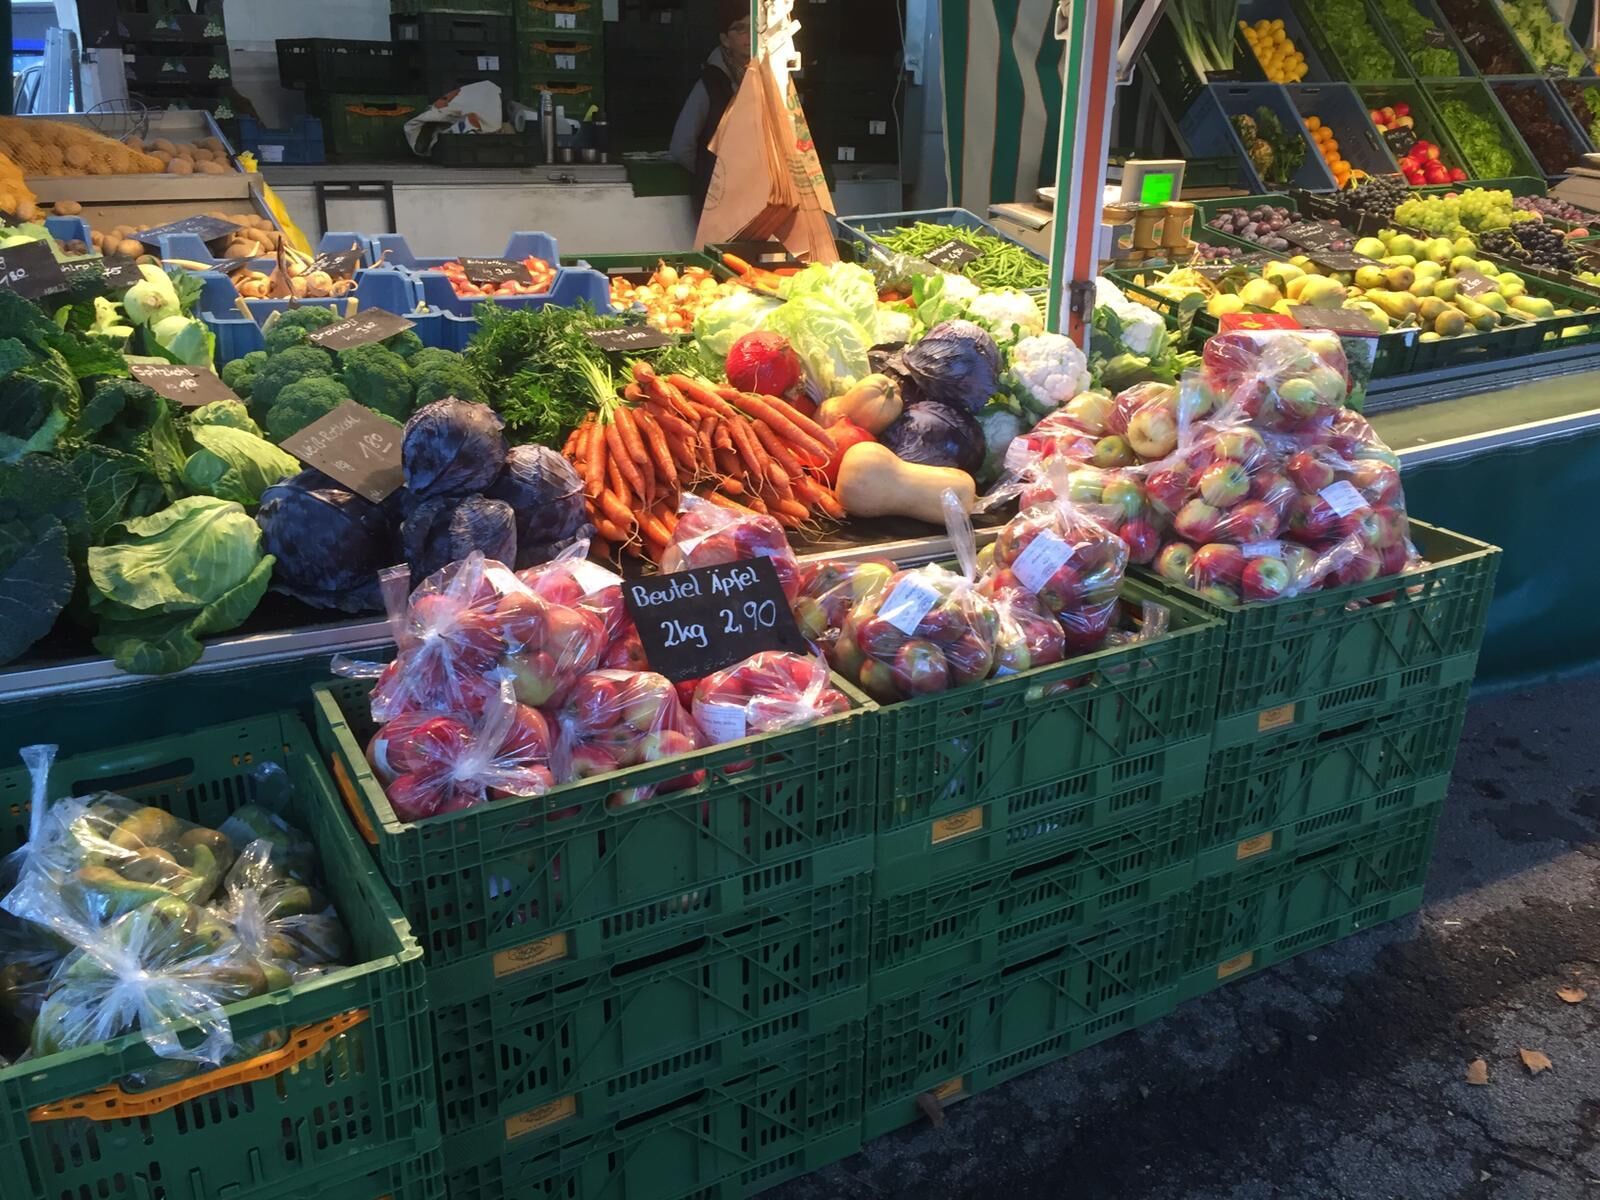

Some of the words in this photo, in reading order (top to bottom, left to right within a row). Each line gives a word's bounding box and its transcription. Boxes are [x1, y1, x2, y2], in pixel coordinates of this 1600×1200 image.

[631, 574, 702, 607] Beutel
[707, 566, 760, 594] Äpfel
[660, 619, 709, 648] 2kg
[719, 599, 776, 632] 2,90
